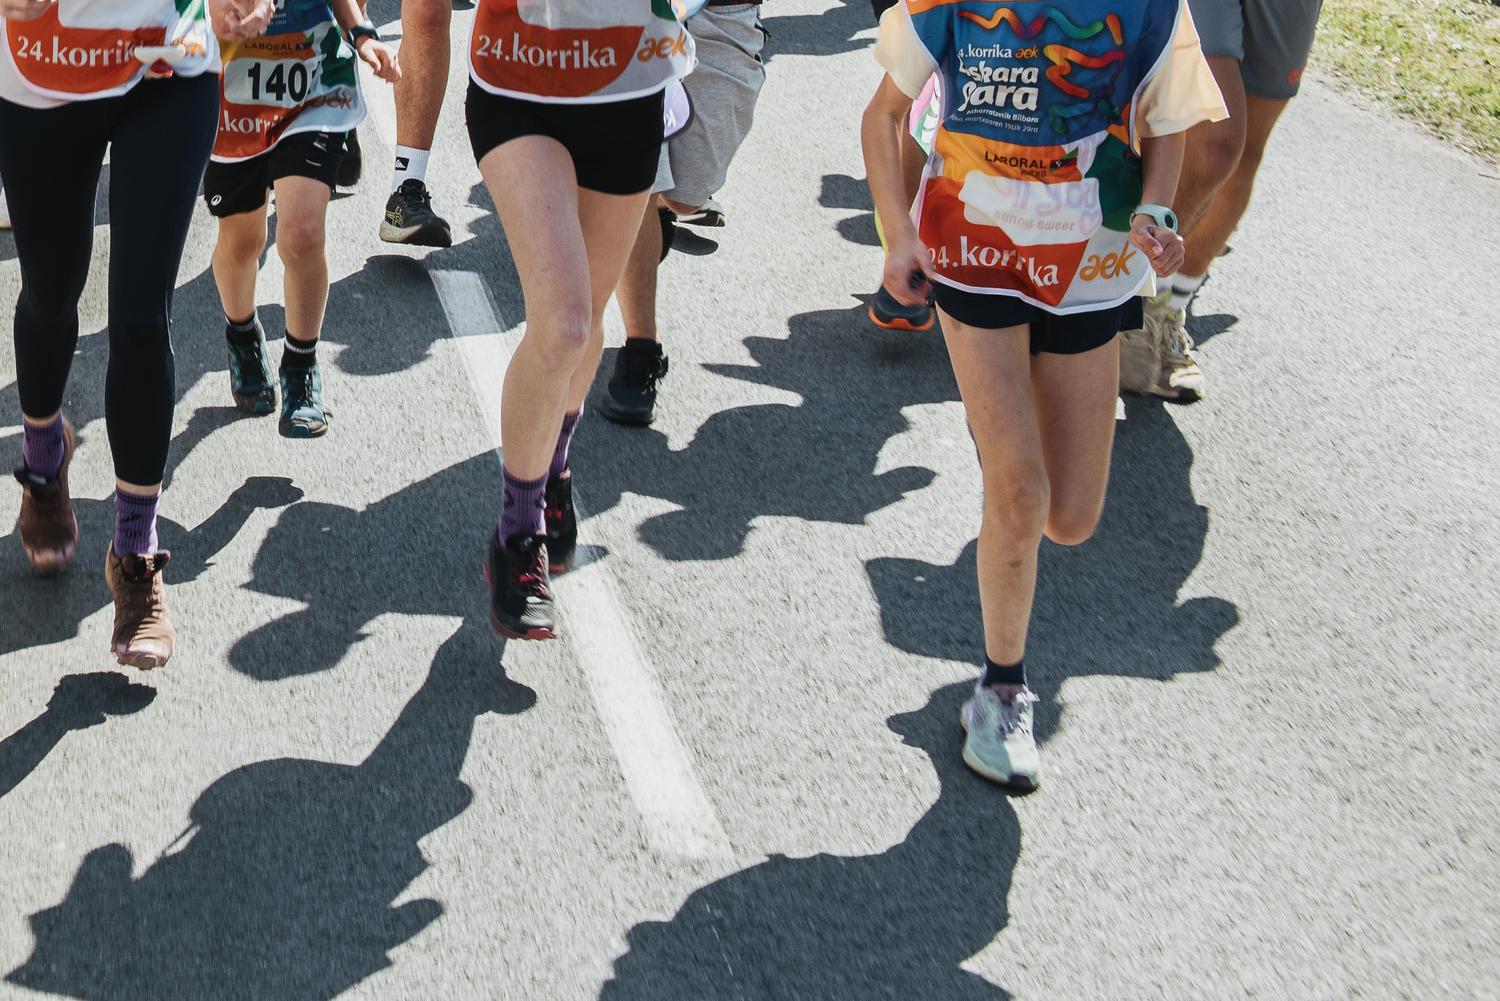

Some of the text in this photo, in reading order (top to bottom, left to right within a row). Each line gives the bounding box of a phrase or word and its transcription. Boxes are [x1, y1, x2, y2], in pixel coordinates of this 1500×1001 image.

[16, 35, 141, 68] 24.korrik
[245, 43, 293, 56] LABORAL
[475, 32, 617, 70] 24.korrika
[636, 28, 689, 63] aek
[958, 44, 1040, 59] 4.korrika aek
[248, 61, 317, 103] 140
[1012, 112, 1040, 124] Bilbora
[1022, 124, 1039, 133] 29ra
[1036, 220, 1076, 232] sweet
[1078, 240, 1137, 282] aek
